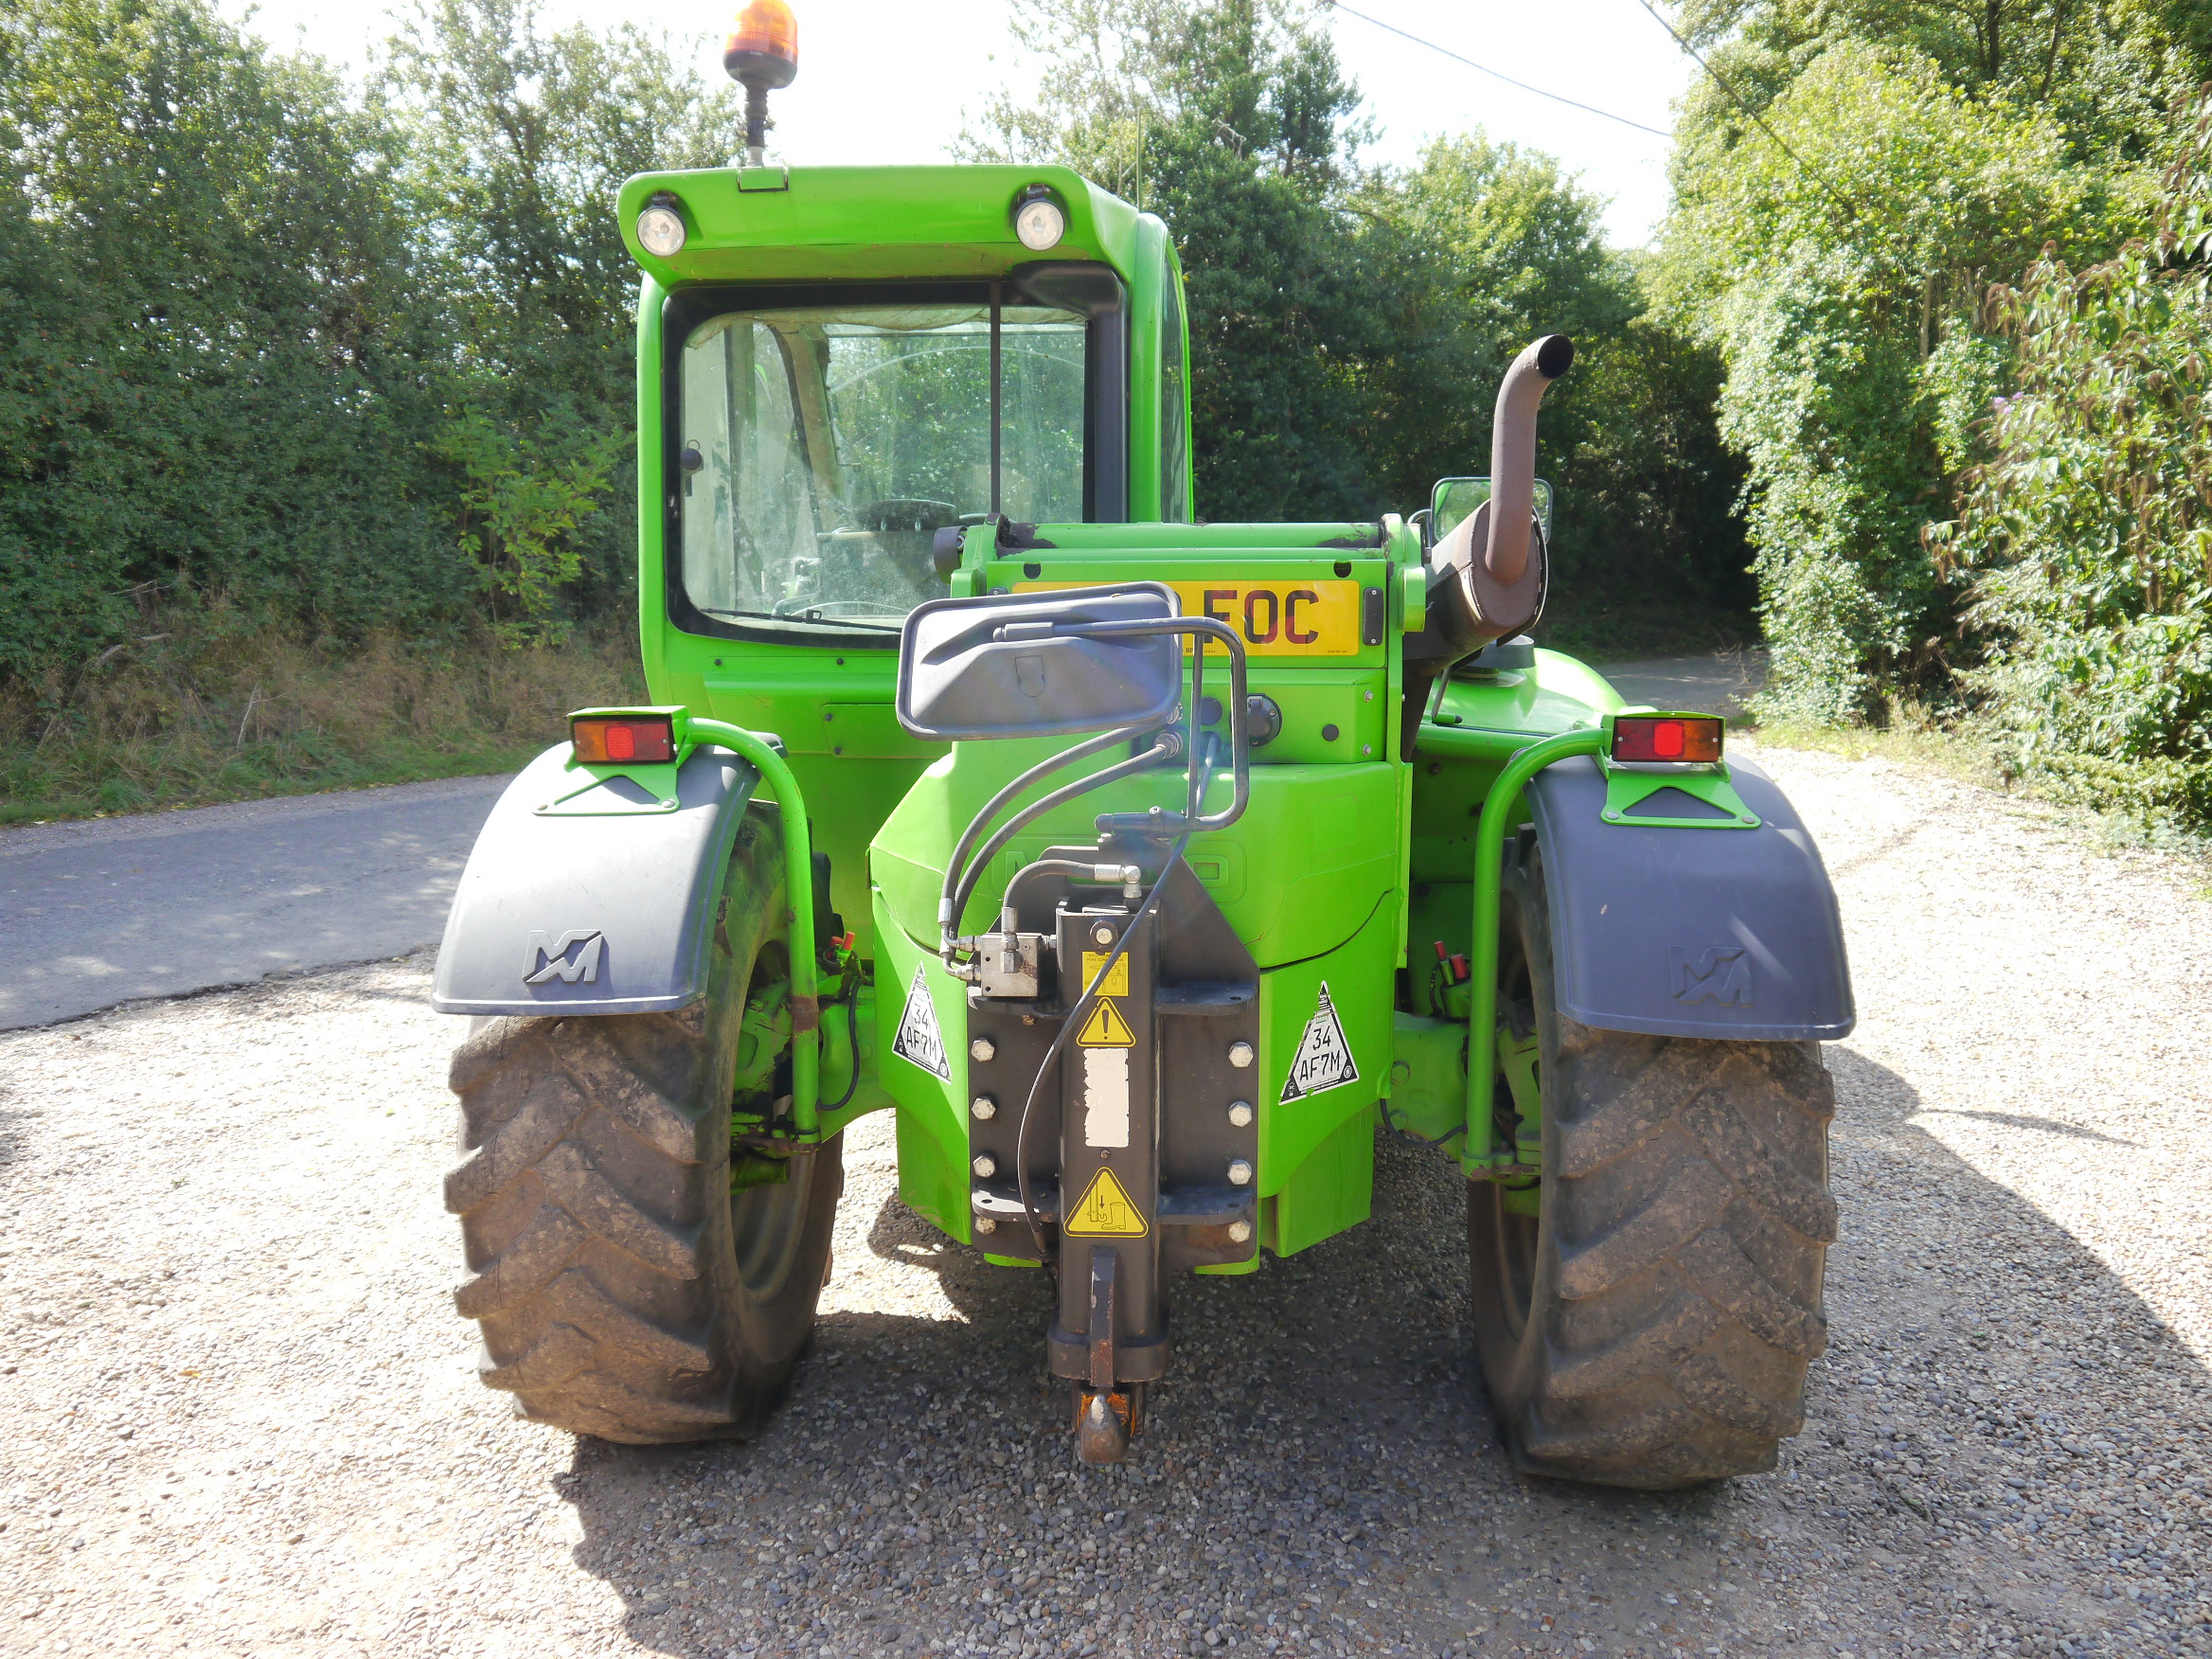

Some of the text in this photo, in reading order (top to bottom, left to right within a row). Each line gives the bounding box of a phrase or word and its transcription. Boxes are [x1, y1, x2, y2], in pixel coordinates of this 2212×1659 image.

[1203, 589, 1320, 644] FOC
[914, 1002, 929, 1030] 34
[906, 1026, 937, 1061] AF7M
[1312, 1025, 1331, 1051] 34
[1299, 1049, 1341, 1081] AF7M
